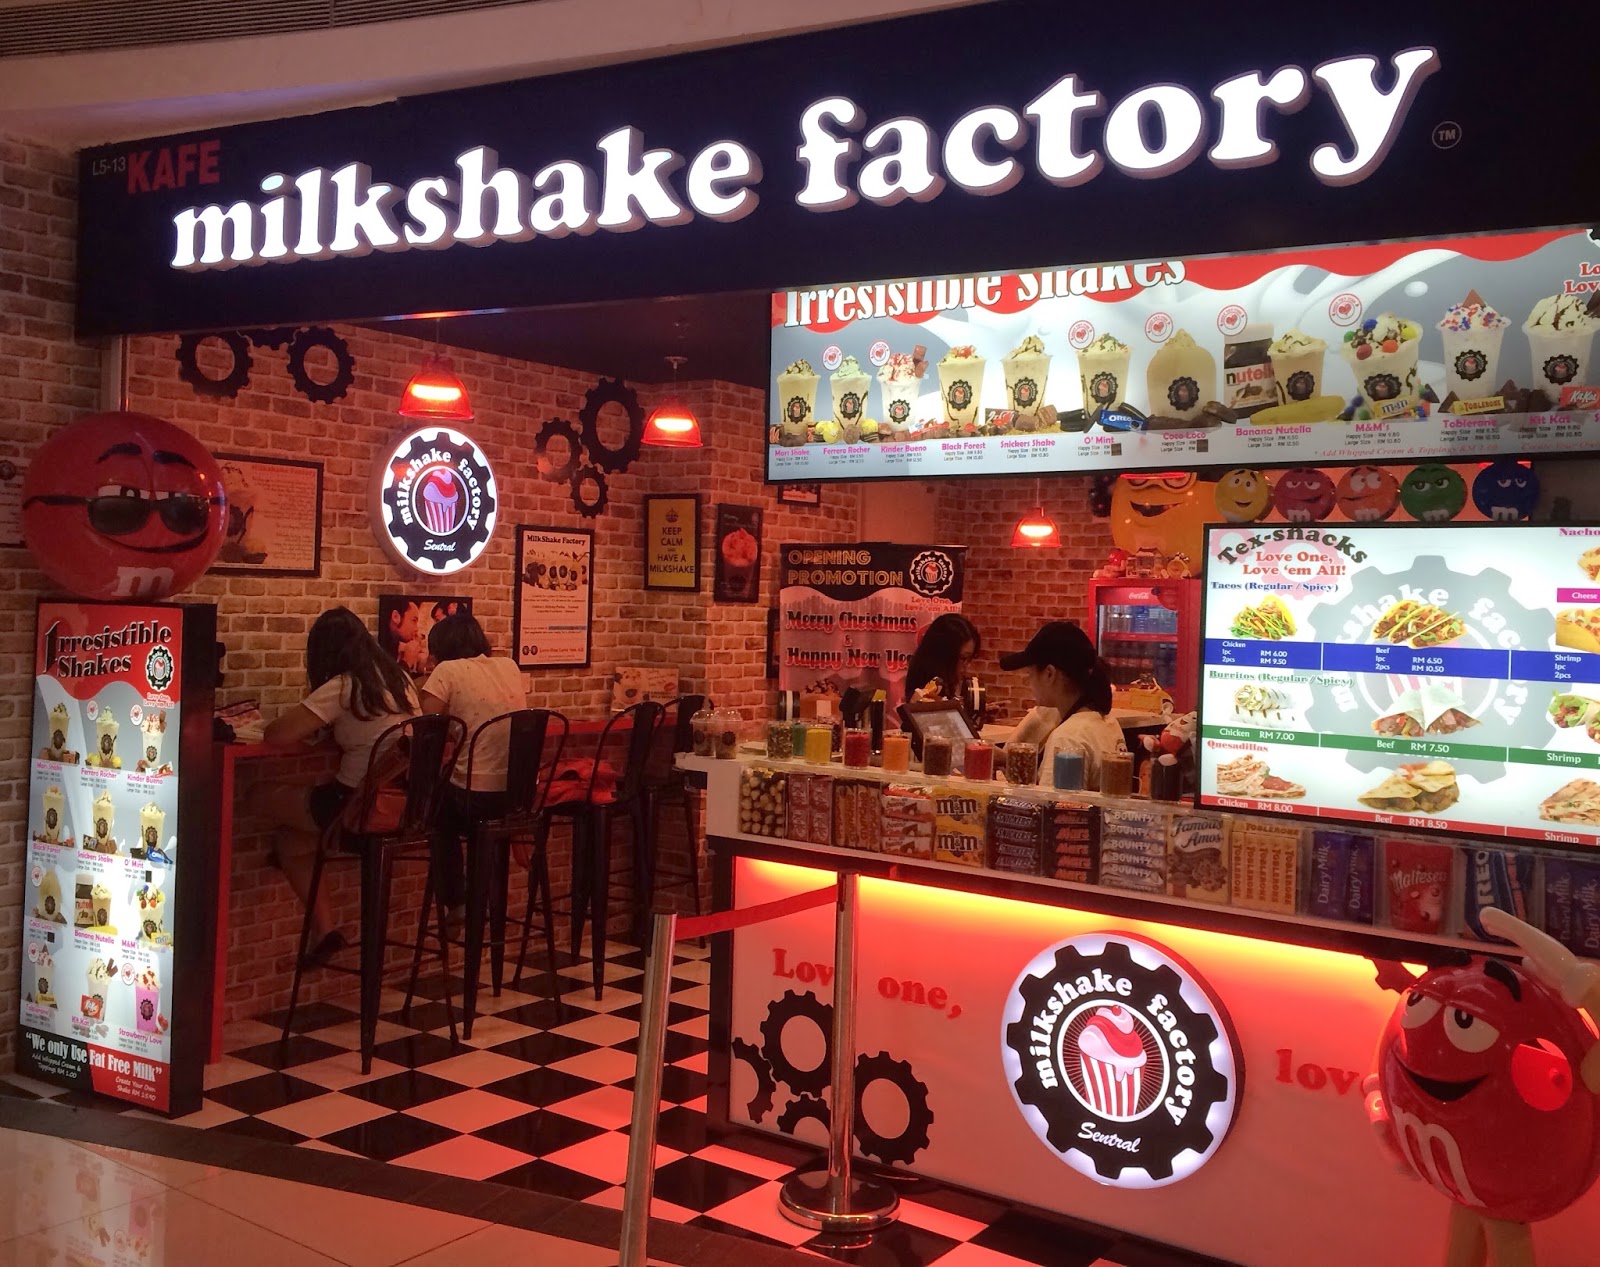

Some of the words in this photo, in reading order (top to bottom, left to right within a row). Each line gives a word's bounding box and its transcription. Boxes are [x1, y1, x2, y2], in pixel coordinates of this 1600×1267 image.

[169, 125, 762, 271] milkshake
[795, 46, 1441, 212] factory
[92, 156, 126, 176] L5-13
[127, 140, 221, 194] KAFE
[1108, 414, 1132, 422] OREO
[1443, 418, 1498, 428] Toblerone
[1236, 427, 1272, 436] Banana
[1275, 425, 1312, 434] Nutella
[1355, 422, 1390, 432] M&M's
[1095, 435, 1114, 444] Mint
[1163, 432, 1184, 440] Coco
[1186, 431, 1206, 439] Loco
[881, 445, 903, 453] Kinder
[905, 444, 927, 452] Bueno
[941, 443, 961, 452] Black
[963, 441, 986, 451] Forest
[1000, 440, 1030, 448] Snickers
[1032, 438, 1055, 447] Shake
[823, 447, 847, 455] Ferrero
[848, 446, 870, 454] Rocher
[397, 447, 452, 526] milkshake
[457, 458, 483, 531] factory
[662, 527, 682, 536] KEEP
[423, 539, 457, 552] Sentral
[660, 538, 683, 547] CALM
[1217, 528, 1368, 566] Tex-snacks
[657, 554, 679, 562] HAVE
[788, 550, 872, 565] OPENING
[1256, 551, 1293, 563] Love
[1297, 551, 1333, 564] One,
[649, 564, 695, 574] MILKSHAKE
[1242, 564, 1279, 576] Love
[1316, 564, 1346, 576] All!
[787, 570, 903, 586] PROMOTION
[1211, 581, 1242, 590] Tacos
[1244, 581, 1293, 592] (Regular
[1302, 582, 1339, 593] Spicy)
[1571, 591, 1598, 600] Cheese
[786, 611, 834, 633] Merry
[838, 611, 918, 632] Christmas
[43, 620, 172, 674] Irresistible
[785, 647, 843, 670] Happy
[846, 648, 881, 668] New
[1273, 650, 1288, 658] 6.00
[1555, 654, 1581, 663] Shrimp
[56, 652, 132, 678] Shakes
[1260, 657, 1272, 665] RM
[1412, 656, 1426, 664] RM
[1426, 657, 1443, 665] 6.50
[1375, 663, 1390, 671] 2pcs
[1411, 664, 1424, 672] RM
[1425, 665, 1445, 673] 10.50
[1209, 670, 1255, 680] Burritos
[1554, 671, 1571, 680] 2pcs
[1219, 728, 1250, 738] Chicken
[1259, 730, 1274, 740] RM
[1275, 731, 1295, 741] 7.00
[1207, 740, 1268, 752] Quesadillas
[1376, 739, 1395, 749] Beef
[1410, 741, 1427, 752] RM
[1429, 743, 1450, 753] 7.50
[1546, 753, 1582, 764] Shrimp
[127, 773, 145, 783] Kinder
[146, 776, 163, 785] Bueno
[1217, 797, 1248, 808] Chicken
[1257, 801, 1272, 812] RM
[1273, 803, 1293, 813] 8.00
[1114, 811, 1153, 822] BOUNTY
[1375, 814, 1393, 824] Beef
[1408, 817, 1425, 828] RM
[1427, 819, 1448, 830] 8.50
[1110, 824, 1150, 837] BOUNTY
[1171, 816, 1224, 838] Famous
[1245, 823, 1299, 836] TOBLERONE
[1181, 832, 1222, 848] Amos
[1544, 832, 1580, 844] Shrimp
[1111, 840, 1151, 850] BOUNTY
[1112, 852, 1151, 865] BOUNTY
[1112, 865, 1151, 877] BOUNTY
[1318, 871, 1332, 904] Dairy
[74, 929, 94, 940] Banana
[94, 932, 115, 945] Nutella
[772, 948, 834, 987] Lov
[877, 976, 963, 1020] one,
[1030, 968, 1133, 1090] milkshake
[1146, 993, 1197, 1127] factory
[47, 1039, 69, 1060] only
[70, 1044, 88, 1063] Use
[89, 1049, 106, 1069] Fat
[107, 1053, 131, 1076] Free
[1275, 1048, 1360, 1095] lov
[1077, 1121, 1142, 1153] Sentral
